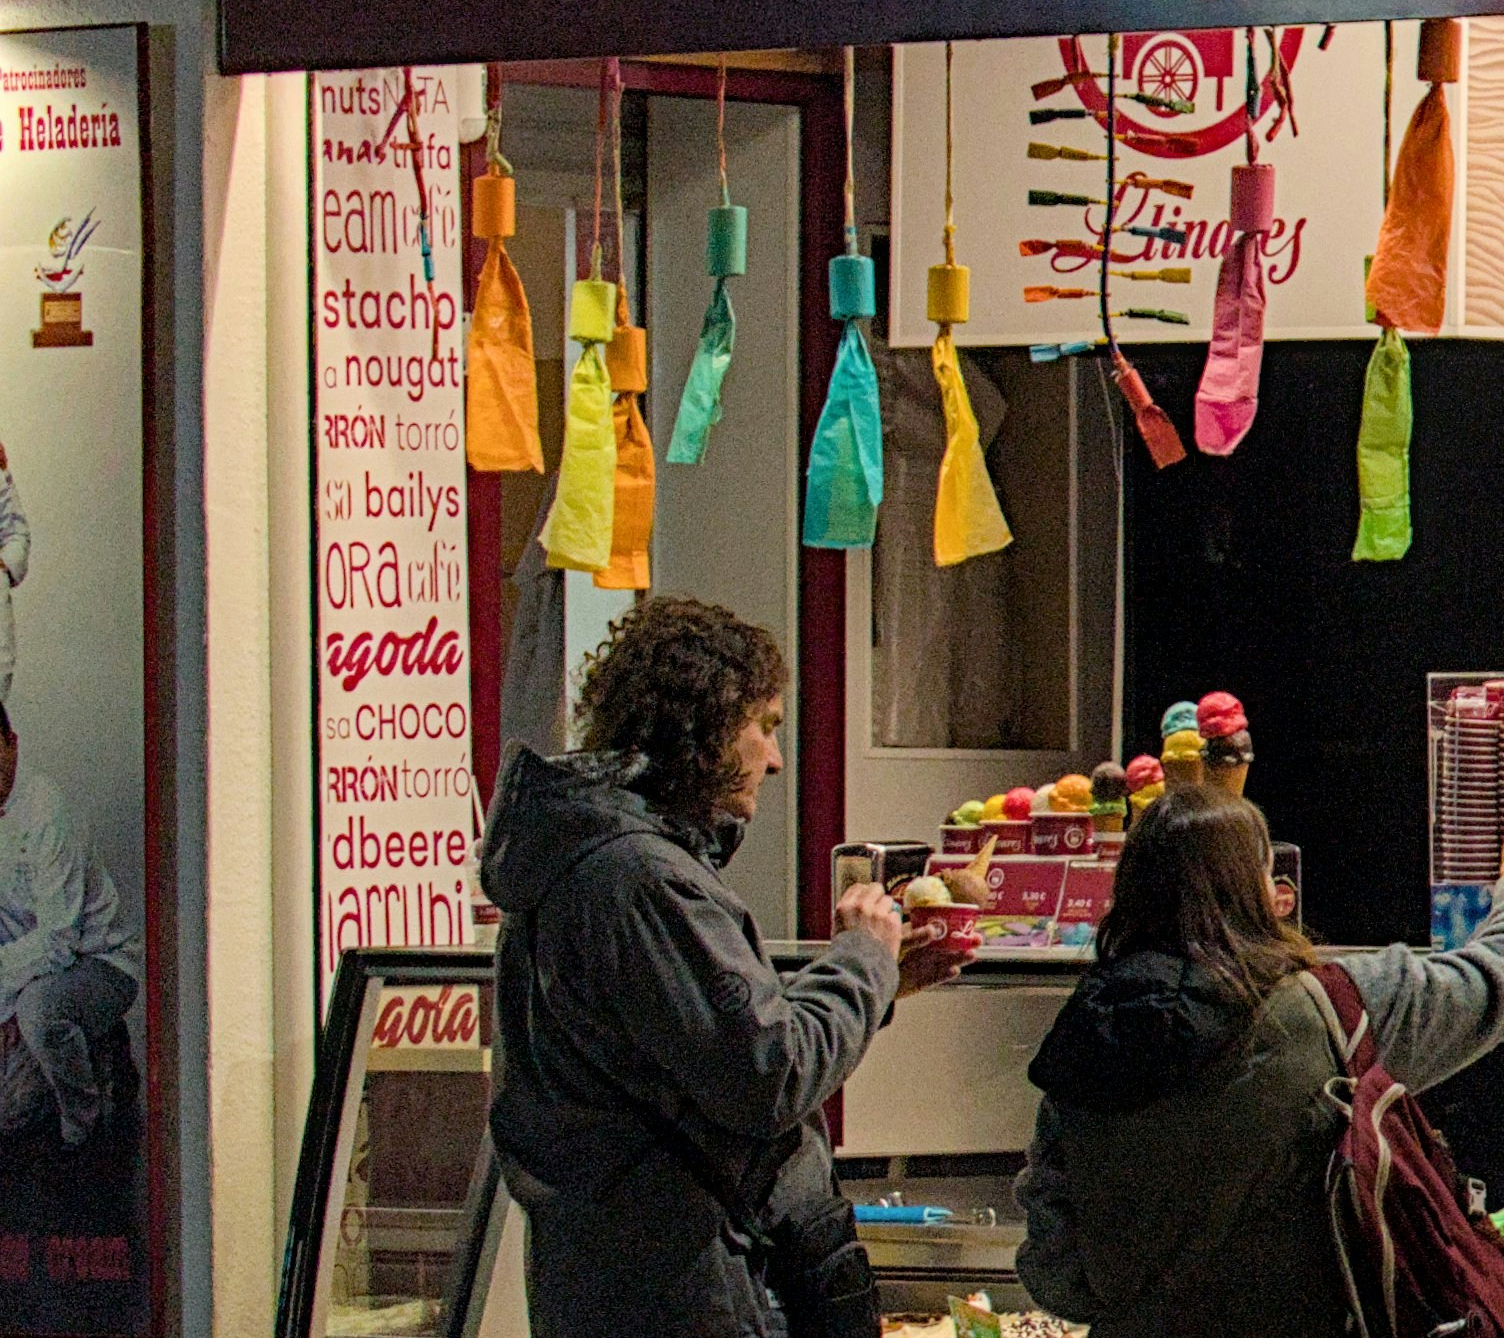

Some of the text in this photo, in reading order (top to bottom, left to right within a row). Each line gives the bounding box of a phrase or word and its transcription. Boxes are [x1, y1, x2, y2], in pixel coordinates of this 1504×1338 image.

[0, 62, 88, 93] atrocinadores
[321, 77, 381, 115] nuts
[18, 101, 122, 152] Heladería
[323, 188, 398, 254] eam
[1051, 171, 1308, 284] Llinaes
[345, 351, 460, 402] nougat
[395, 409, 460, 452] torró
[365, 470, 460, 532] bailys
[407, 540, 461, 603] café
[355, 703, 467, 741] CHOCO
[402, 754, 471, 800] torró
